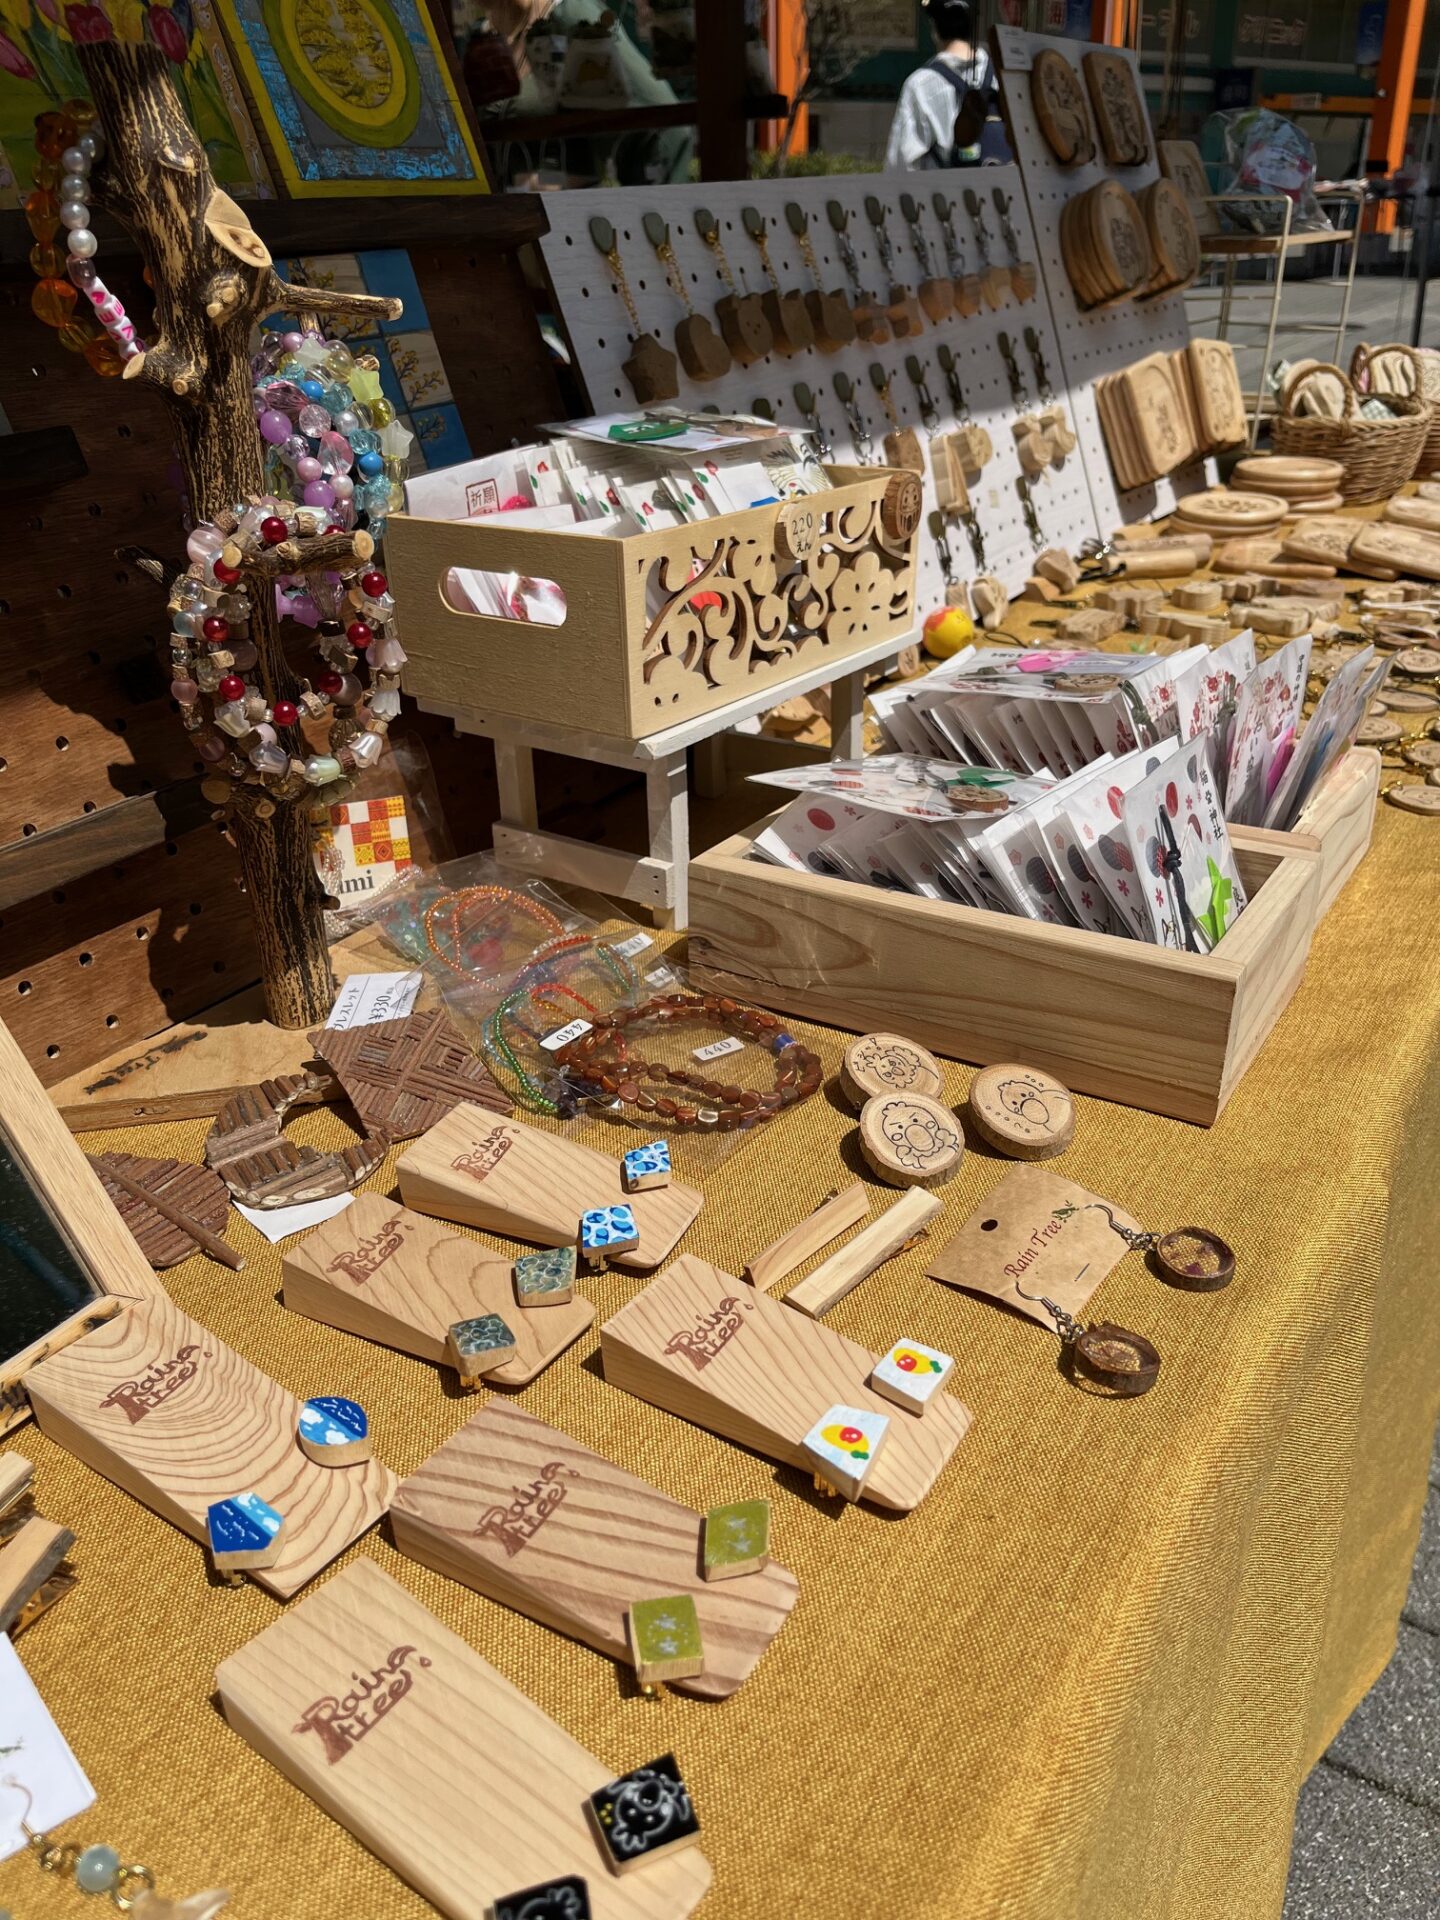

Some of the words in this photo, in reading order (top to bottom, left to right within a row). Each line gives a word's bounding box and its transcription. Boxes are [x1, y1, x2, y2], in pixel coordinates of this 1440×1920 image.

[792, 512, 813, 536] 220
[796, 541, 812, 554] えん
[368, 995, 392, 1020] ¥330
[556, 1022, 584, 1043] 440
[703, 1040, 733, 1056] 440
[1003, 1248, 1039, 1279] Rain
[1030, 1220, 1062, 1248] Tree
